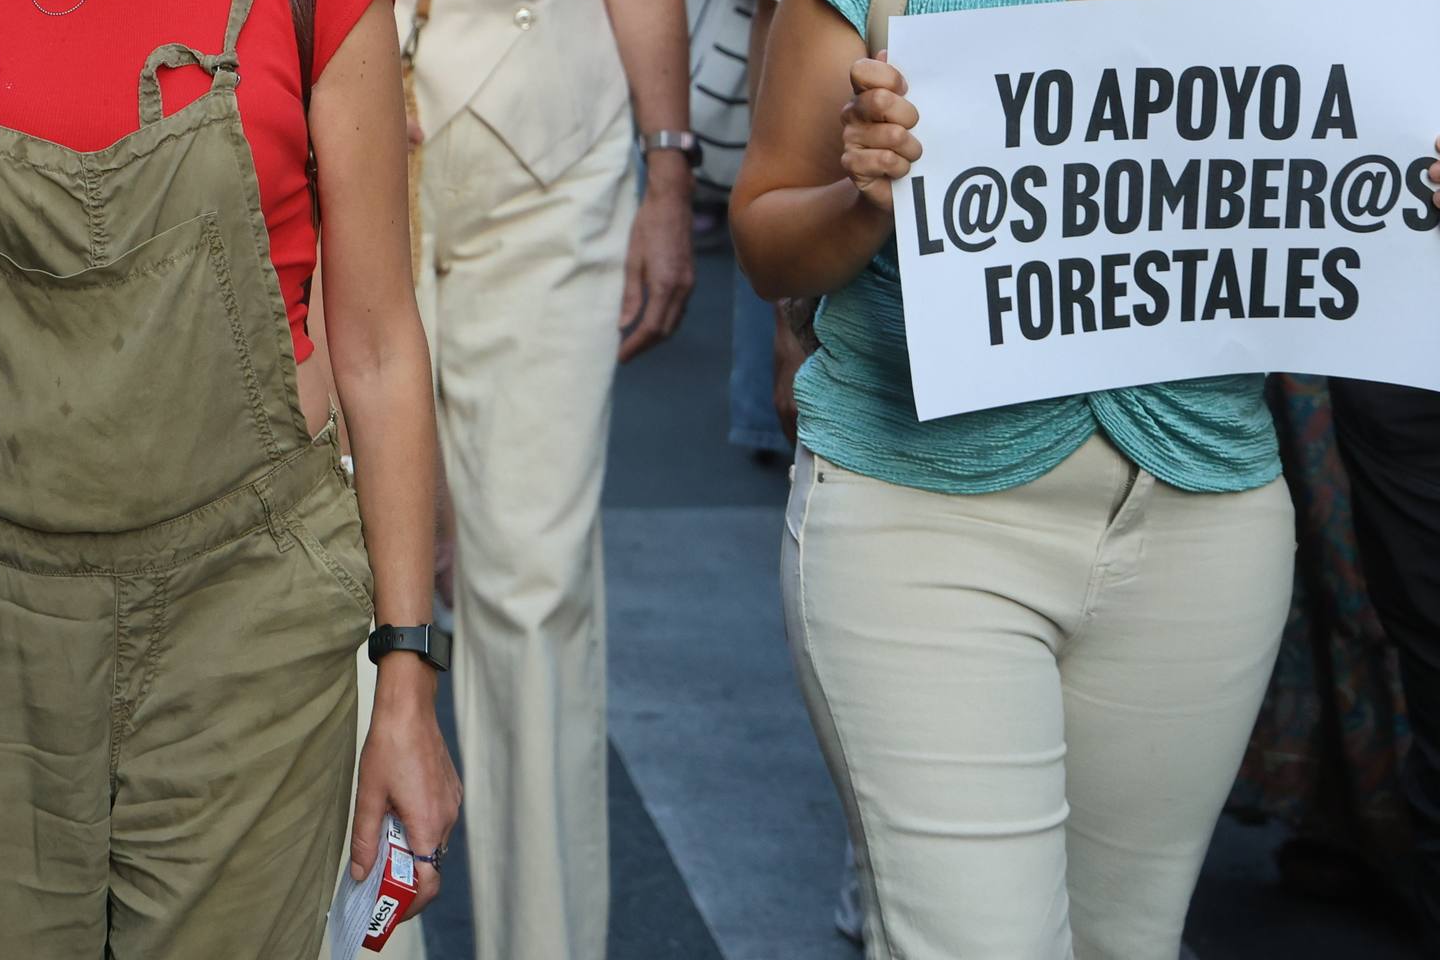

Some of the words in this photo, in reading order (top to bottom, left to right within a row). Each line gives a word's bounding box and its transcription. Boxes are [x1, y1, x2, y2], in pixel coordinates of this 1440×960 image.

[994, 69, 1074, 149] YO
[1084, 64, 1301, 143] APOYO
[1312, 63, 1358, 140] A
[911, 165, 1048, 256] L@S
[1062, 154, 1440, 238] BOMBER@S
[984, 246, 1361, 346] FORESTALES
[368, 899, 394, 931] West
